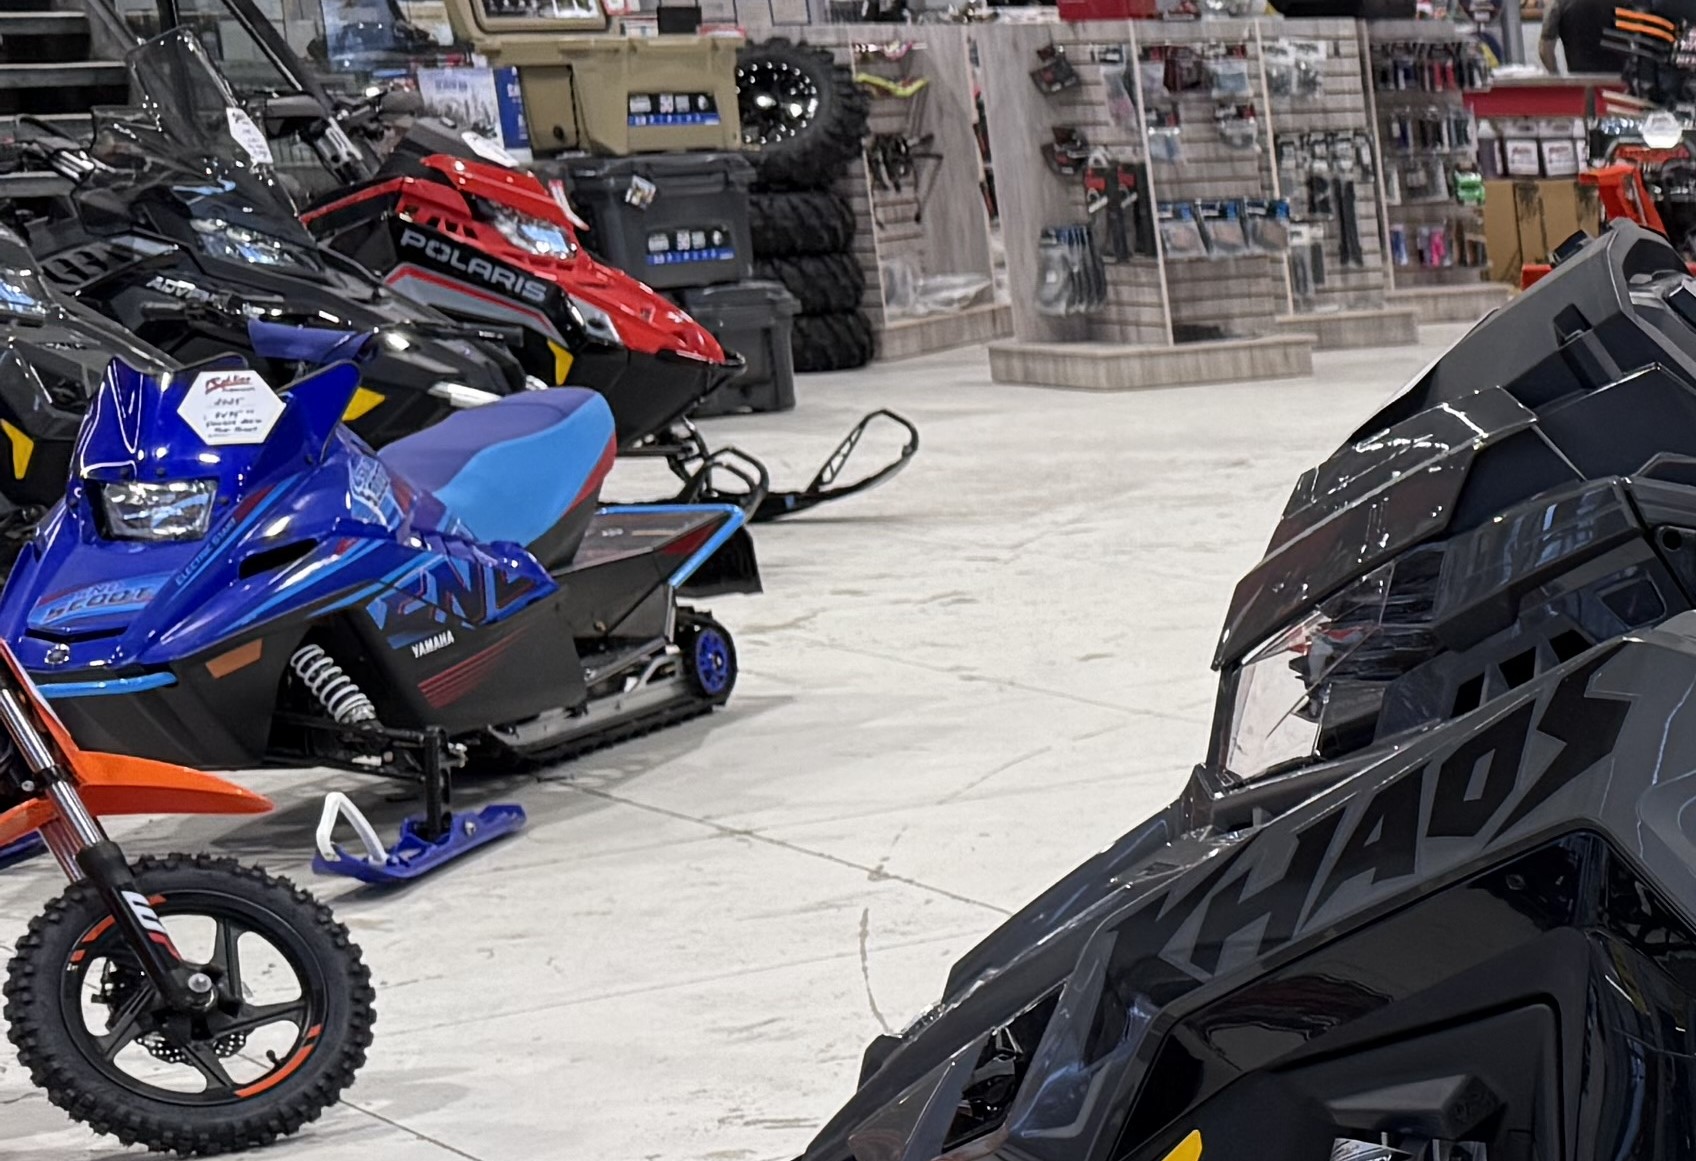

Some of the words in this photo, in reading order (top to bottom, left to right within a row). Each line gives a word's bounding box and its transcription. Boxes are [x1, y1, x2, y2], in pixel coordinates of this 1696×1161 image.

[400, 228, 547, 302] POLARIS
[411, 629, 455, 659] YAMAHA
[1107, 645, 1636, 988] KHAOS
